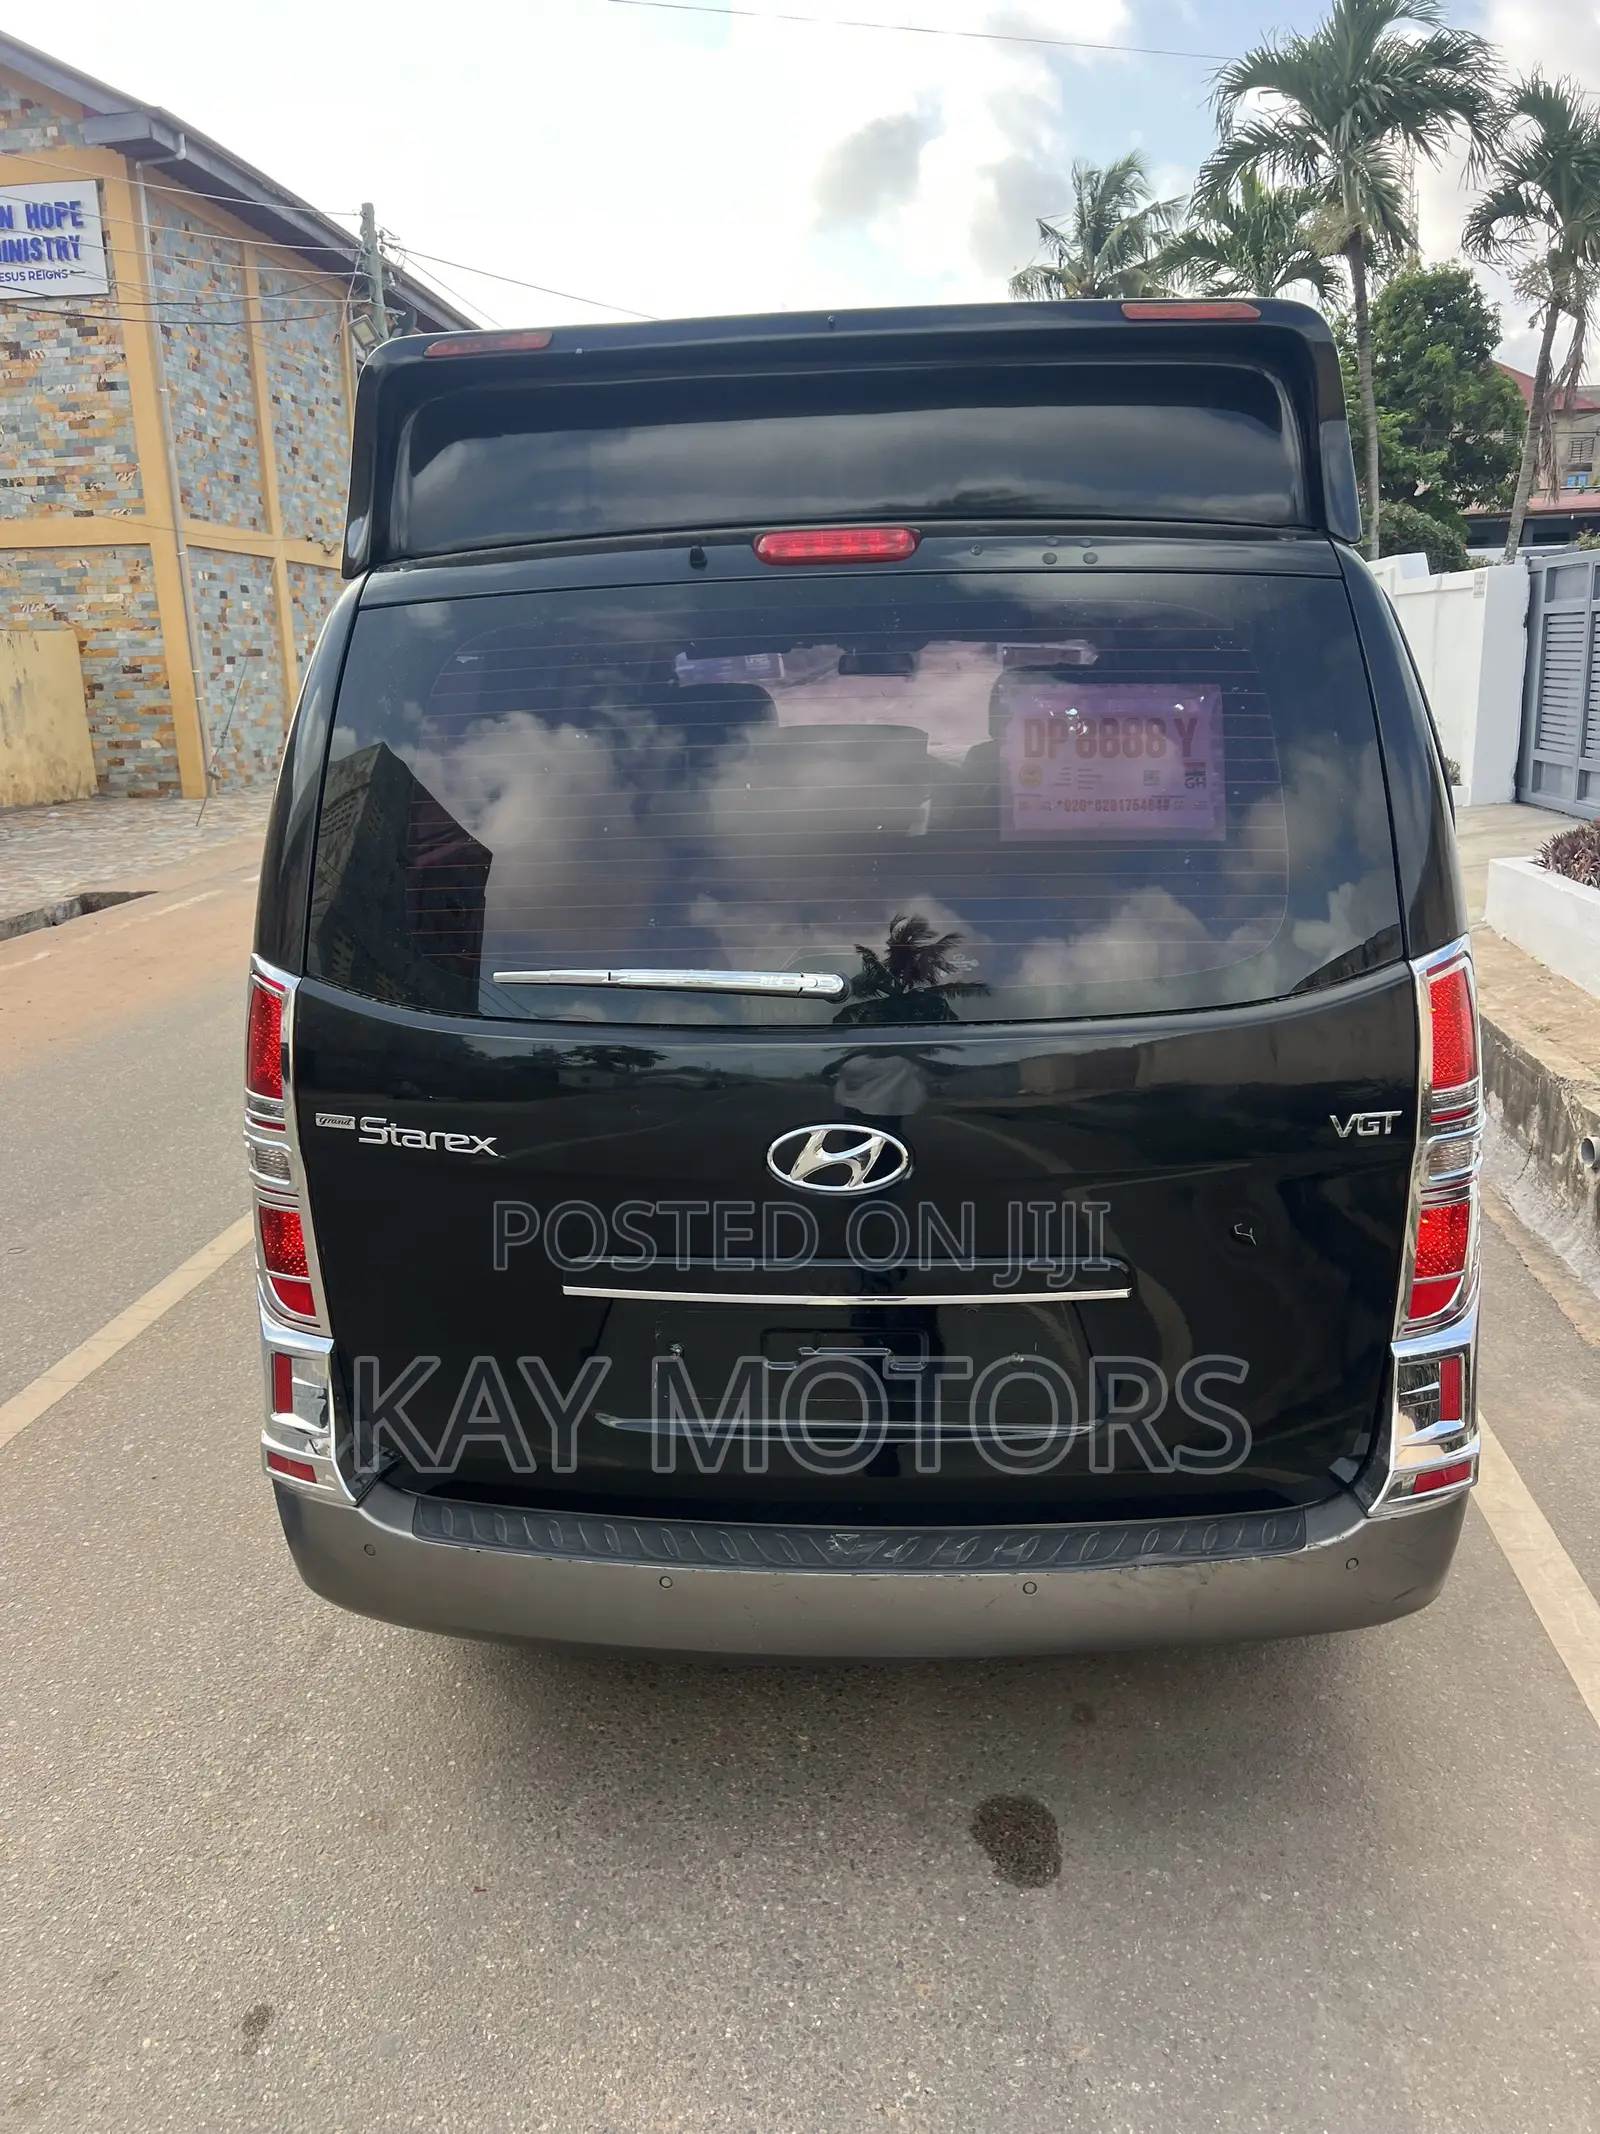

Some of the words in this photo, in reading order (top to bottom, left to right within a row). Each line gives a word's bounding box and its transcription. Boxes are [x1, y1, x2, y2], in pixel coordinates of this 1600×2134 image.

[0, 205, 14, 229] N
[25, 200, 84, 230] HOPE
[0, 235, 81, 262] INISTRY
[28, 269, 68, 281] REIGNS
[1023, 718, 1069, 758] DP
[1174, 718, 1198, 758] Y
[1185, 777, 1206, 790] GH
[358, 1116, 499, 1157] Starex
[1329, 1110, 1403, 1138] VGT
